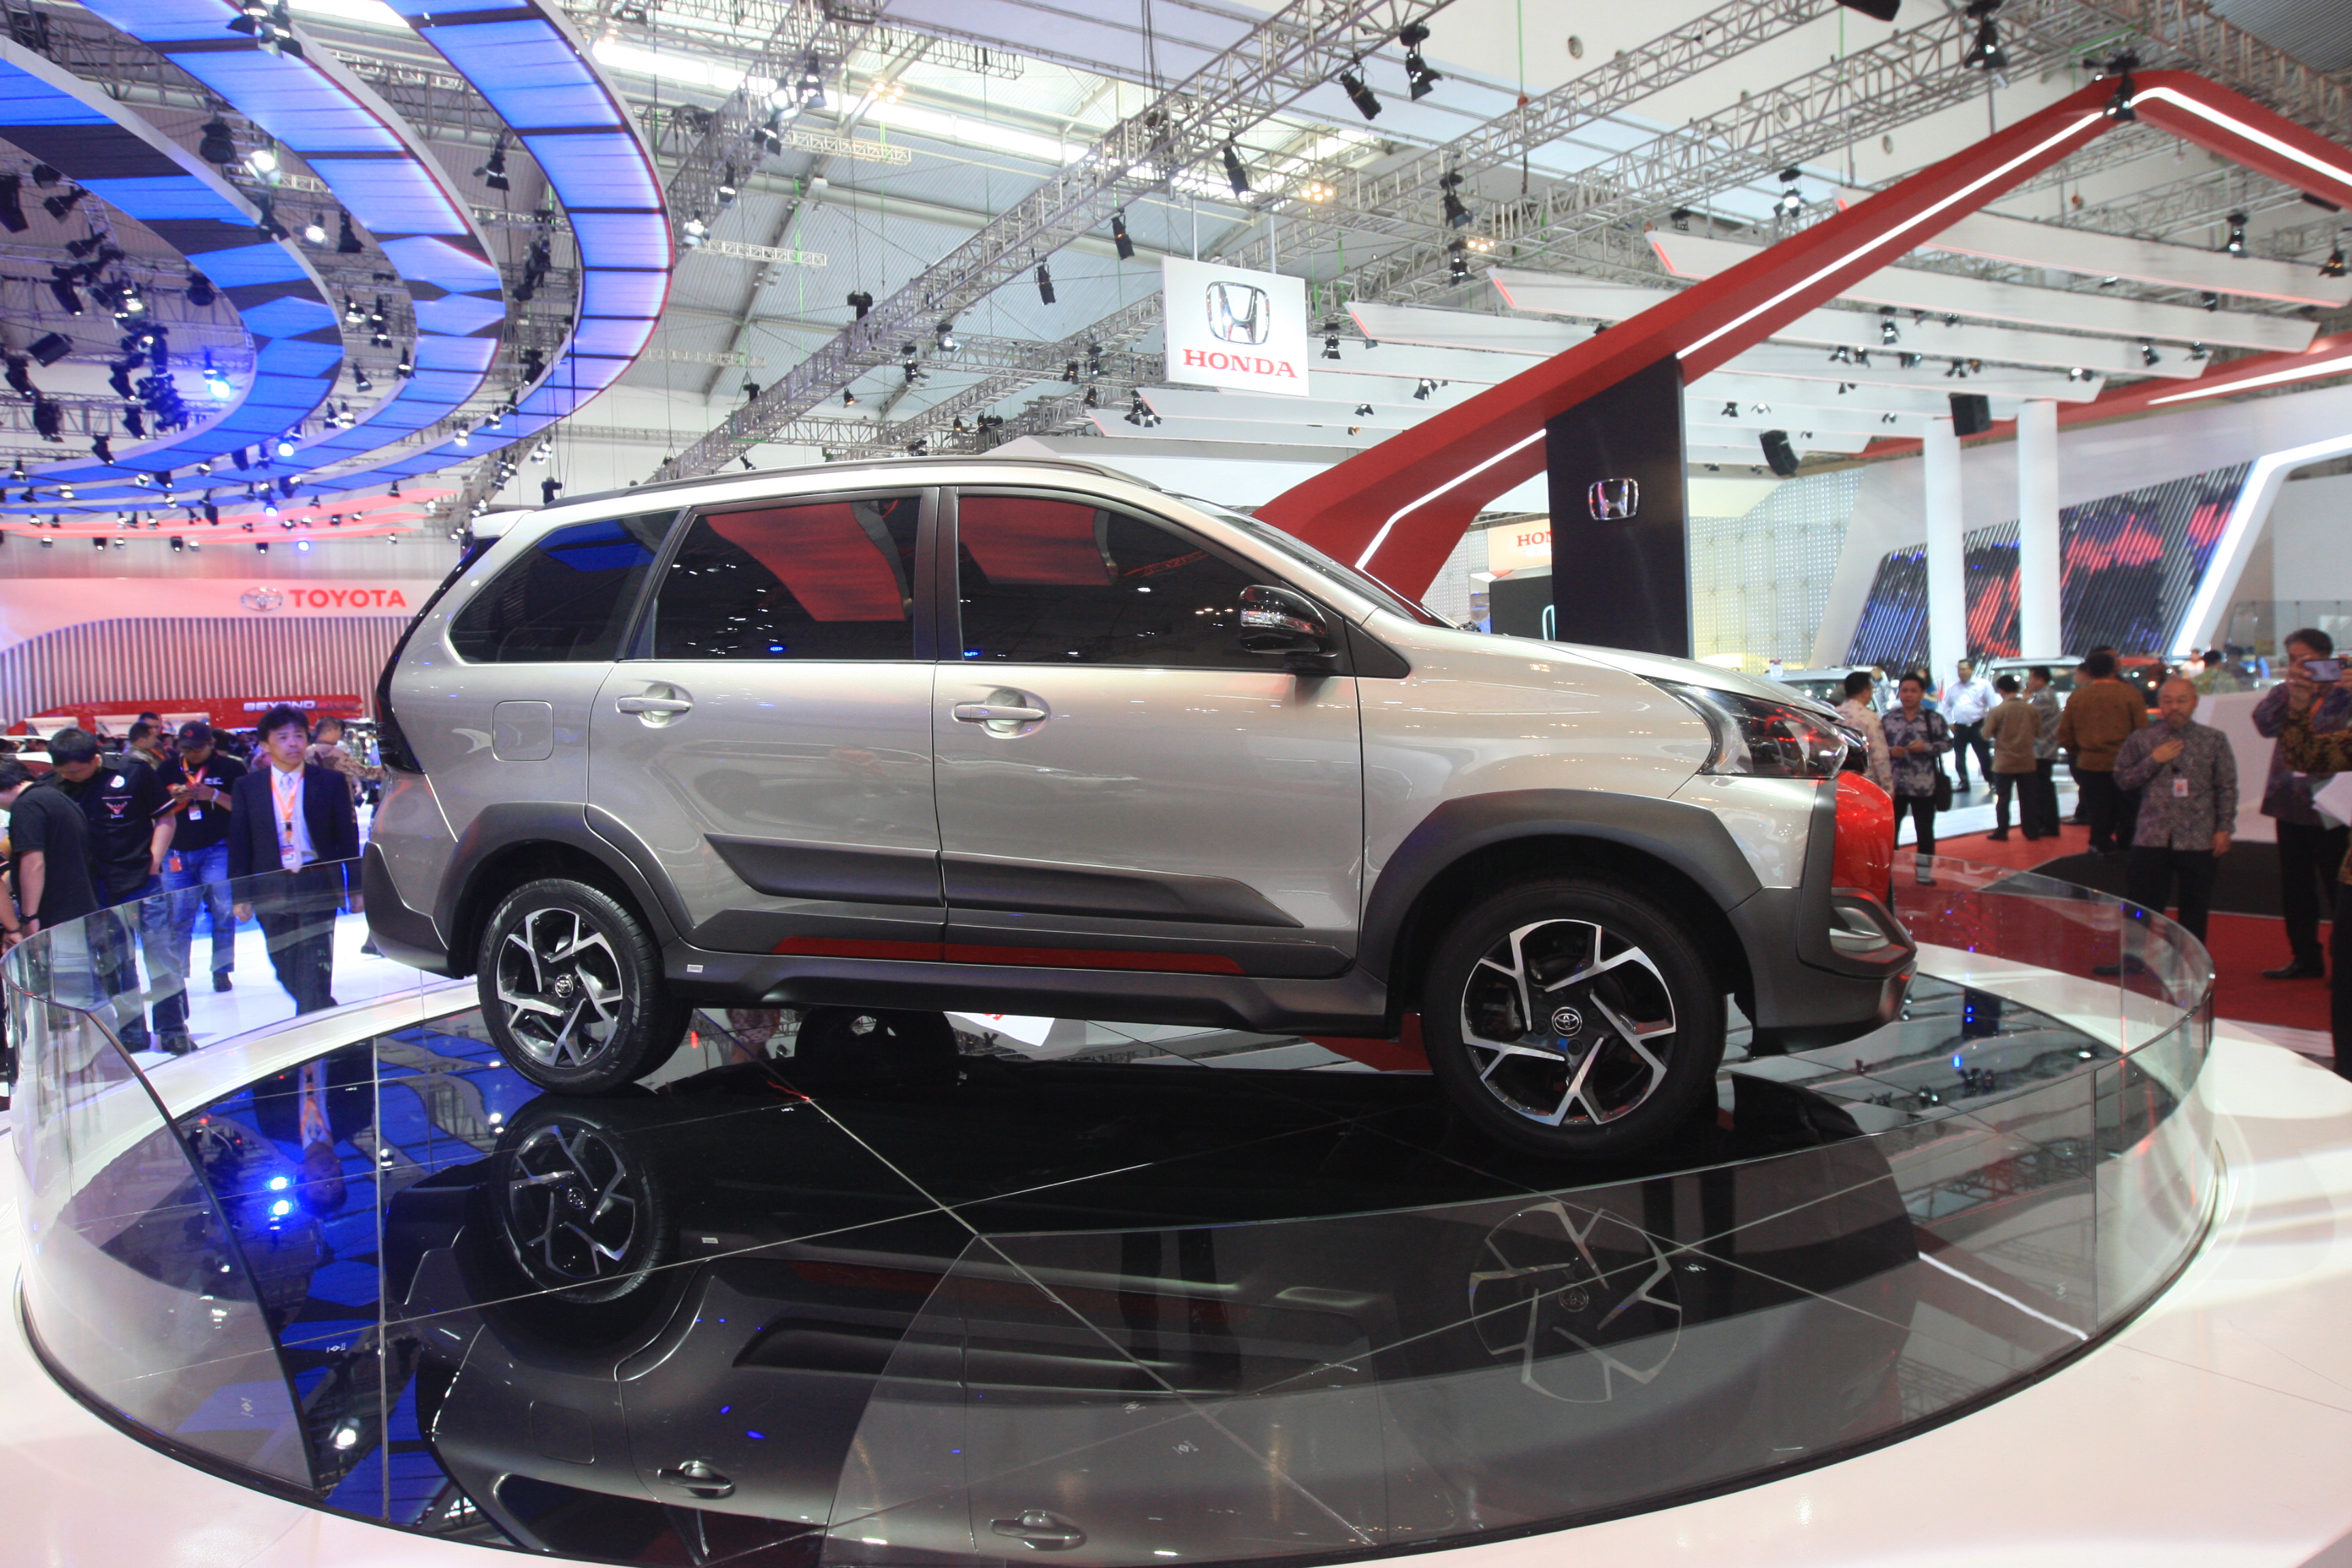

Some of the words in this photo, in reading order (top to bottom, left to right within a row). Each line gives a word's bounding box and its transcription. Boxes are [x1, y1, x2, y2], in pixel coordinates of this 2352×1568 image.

[1183, 348, 1298, 378] HONDA
[1517, 531, 1553, 547] HON
[289, 589, 407, 608] TOYOTA
